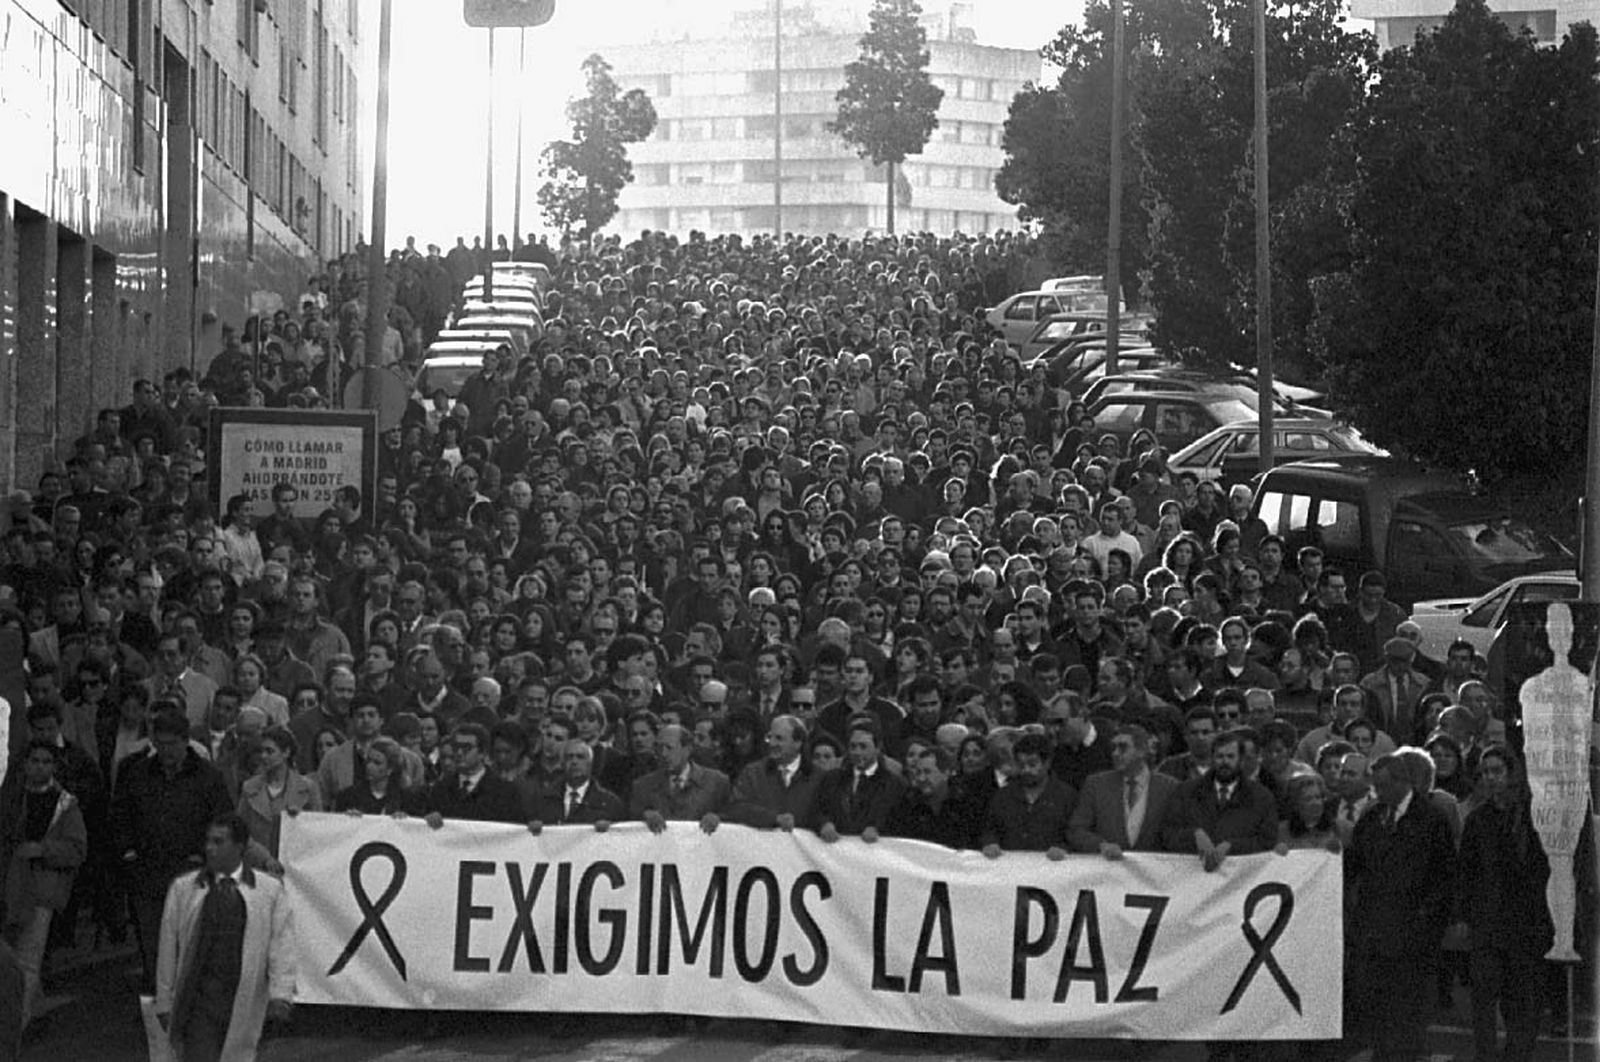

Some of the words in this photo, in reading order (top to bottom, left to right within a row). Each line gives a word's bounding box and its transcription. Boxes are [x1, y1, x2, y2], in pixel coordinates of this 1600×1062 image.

[288, 440, 343, 454] LLAMAR
[260, 456, 269, 468] A
[273, 456, 328, 469] MADRID
[242, 471, 344, 486] AHORRÁNDOTE
[241, 489, 271, 502] HAS
[453, 860, 833, 987] EXIGIMOS
[871, 876, 961, 997] LA
[1010, 885, 1170, 1004] PAZ
